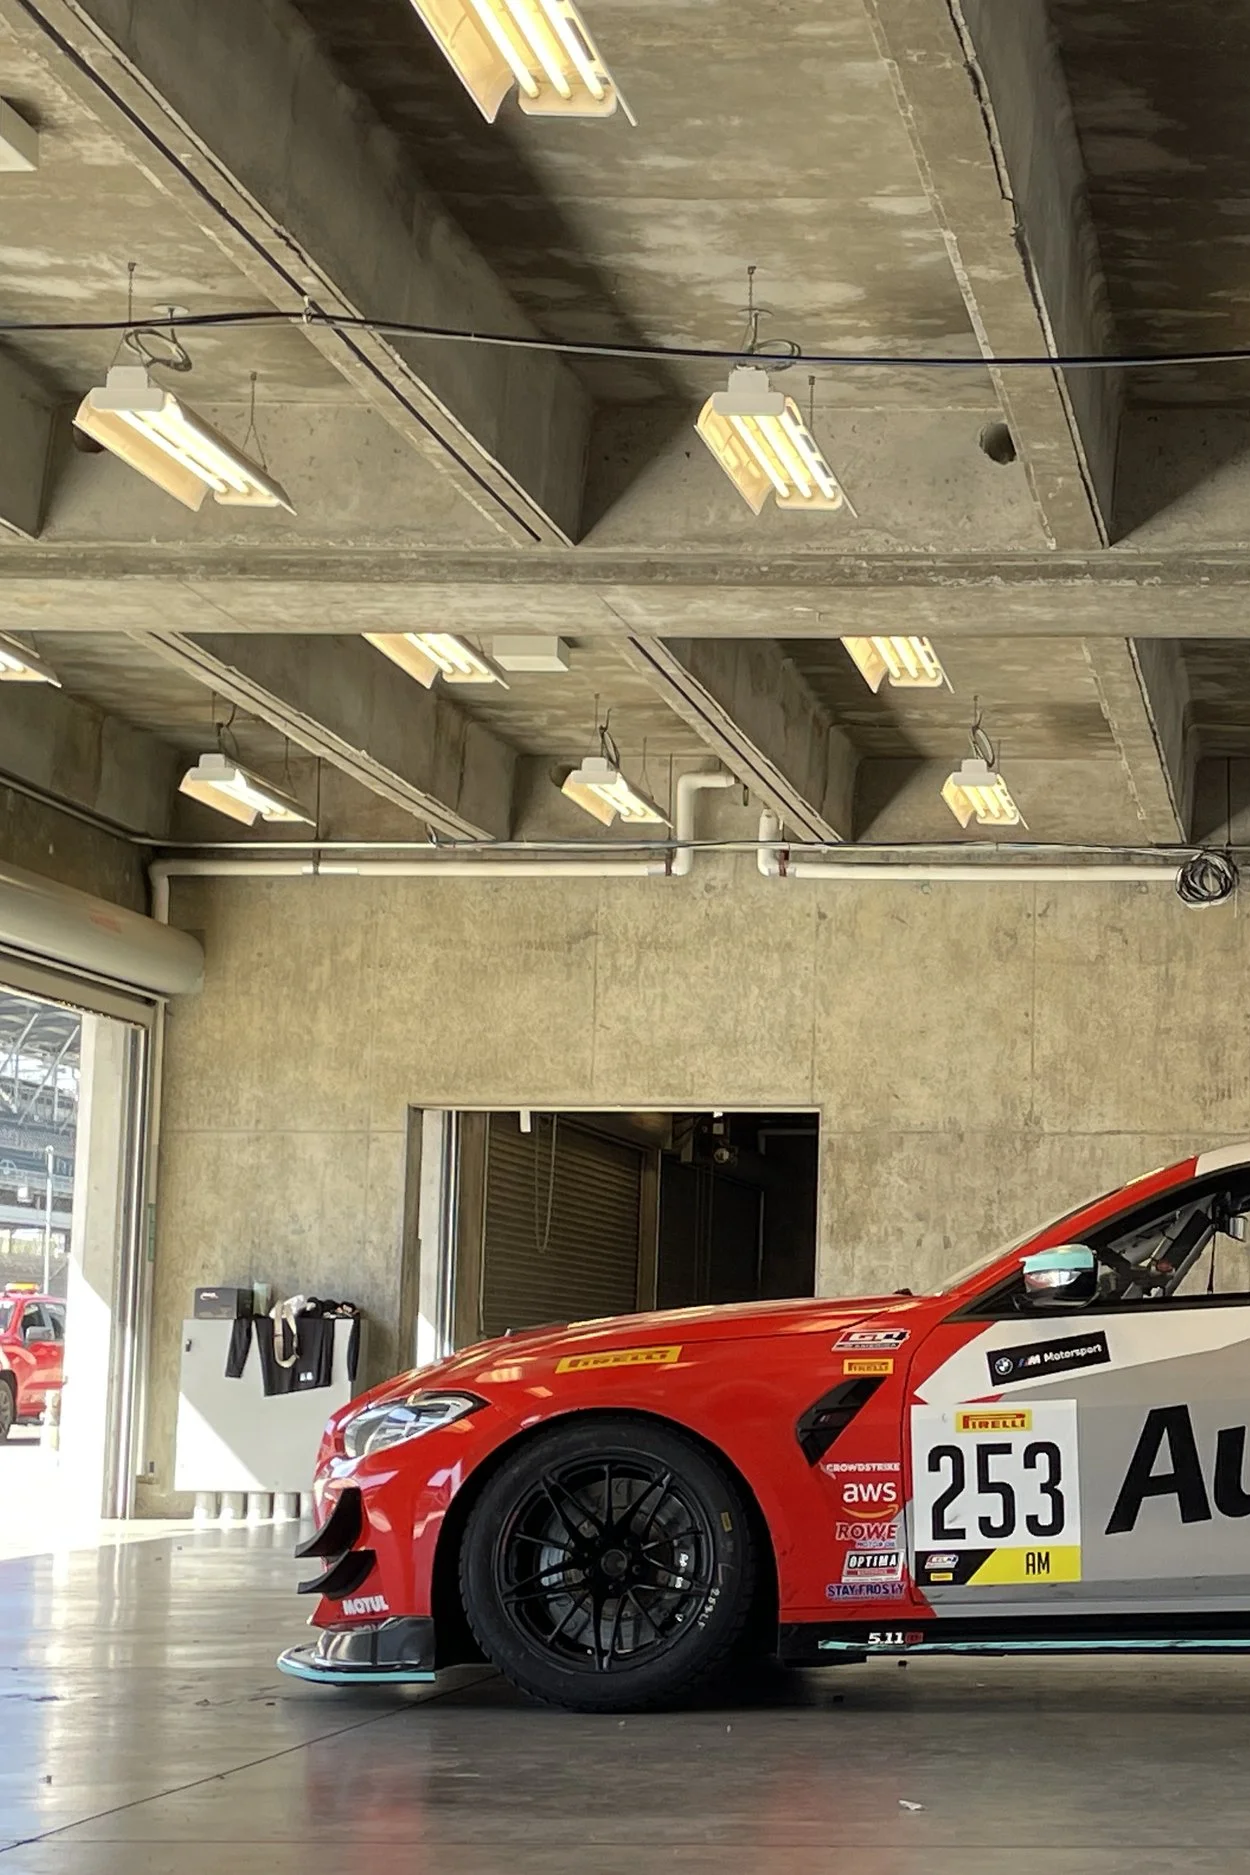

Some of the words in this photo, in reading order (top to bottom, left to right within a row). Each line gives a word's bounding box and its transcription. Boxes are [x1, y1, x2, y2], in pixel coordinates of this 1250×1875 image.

[1043, 1343, 1102, 1363] Motorsport
[962, 1413, 1026, 1430] PIRELLI
[826, 1462, 901, 1473] CROWDSTRIKE
[842, 1482, 898, 1503] aws
[928, 1441, 1065, 1541] 253
[836, 1522, 899, 1541] ROWE
[849, 1554, 898, 1568] OPTIMA
[1025, 1551, 1050, 1575] AM
[827, 1585, 856, 1597] STAY
[858, 1583, 905, 1596] FROSTY
[342, 1595, 390, 1616] MOTUL
[867, 1632, 904, 1645] 5.11
